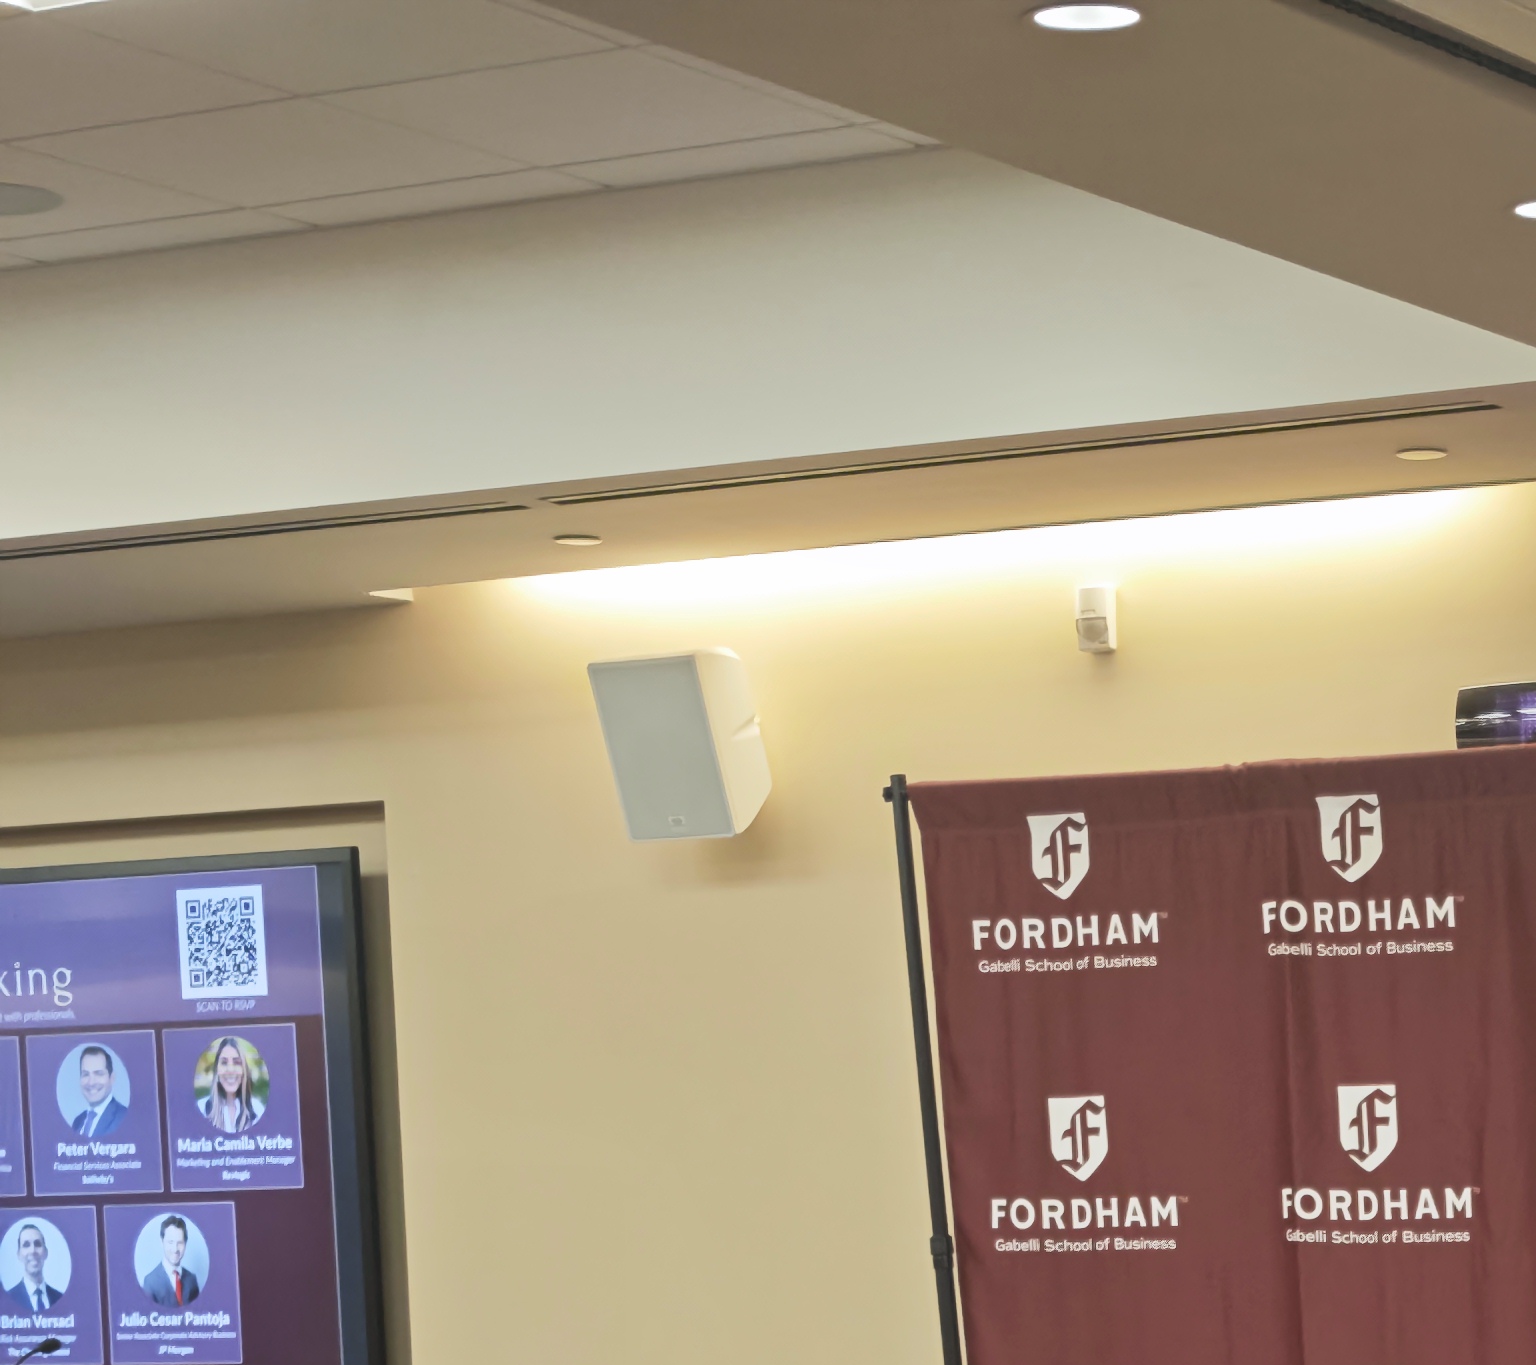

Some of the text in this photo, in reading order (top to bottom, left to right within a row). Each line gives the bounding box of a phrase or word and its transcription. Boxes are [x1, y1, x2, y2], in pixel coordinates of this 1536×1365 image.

[1262, 897, 1456, 934] FORDHAM
[972, 913, 1159, 950] FORDHAM
[1268, 939, 1455, 956] Gabelli School of Business
[978, 954, 1158, 973] Gabelli School of Business
[57, 1142, 136, 1158] Peter Vergara
[1282, 1187, 1473, 1220] FORDHAM
[991, 1197, 1179, 1230] FORDHAM
[994, 1236, 1178, 1253] Gabelli School of Business
[1331, 1230, 1379, 1244] School
[1381, 1230, 1399, 1244] of
[1402, 1228, 1471, 1243] Business
